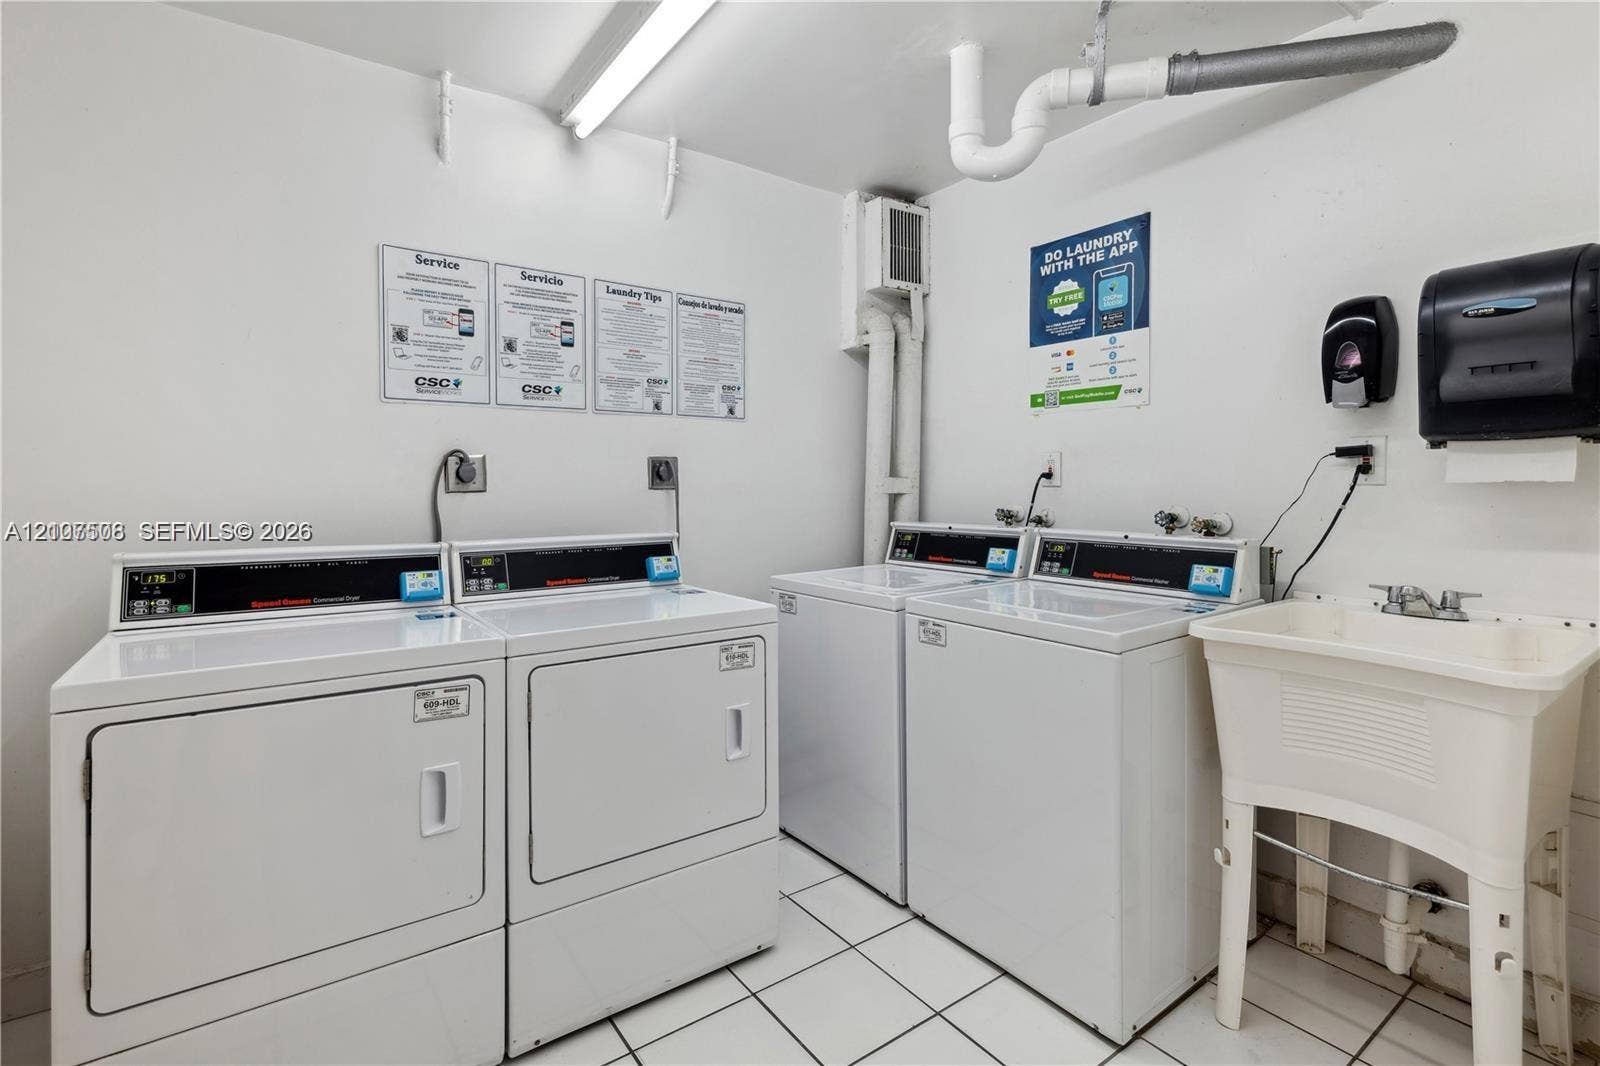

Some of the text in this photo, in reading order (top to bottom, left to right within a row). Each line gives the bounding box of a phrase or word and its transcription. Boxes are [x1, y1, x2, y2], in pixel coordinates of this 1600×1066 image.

[1044, 228, 1134, 264] DO LAUNDRY
[415, 253, 460, 270] Service
[1040, 240, 1139, 277] WITH THE APP
[520, 270, 564, 287] Servicio
[606, 285, 662, 304] Laundry Tips
[1049, 291, 1084, 305] TRY FREE
[678, 297, 701, 309] Consejos
[701, 301, 708, 310] de
[414, 376, 451, 388] CSC
[646, 378, 663, 386] CSC
[521, 384, 553, 395] CSC
[146, 574, 167, 583] 175
[312, 596, 345, 604] Commercial
[345, 594, 361, 602] Dryer
[423, 698, 461, 709] 609-HDL
